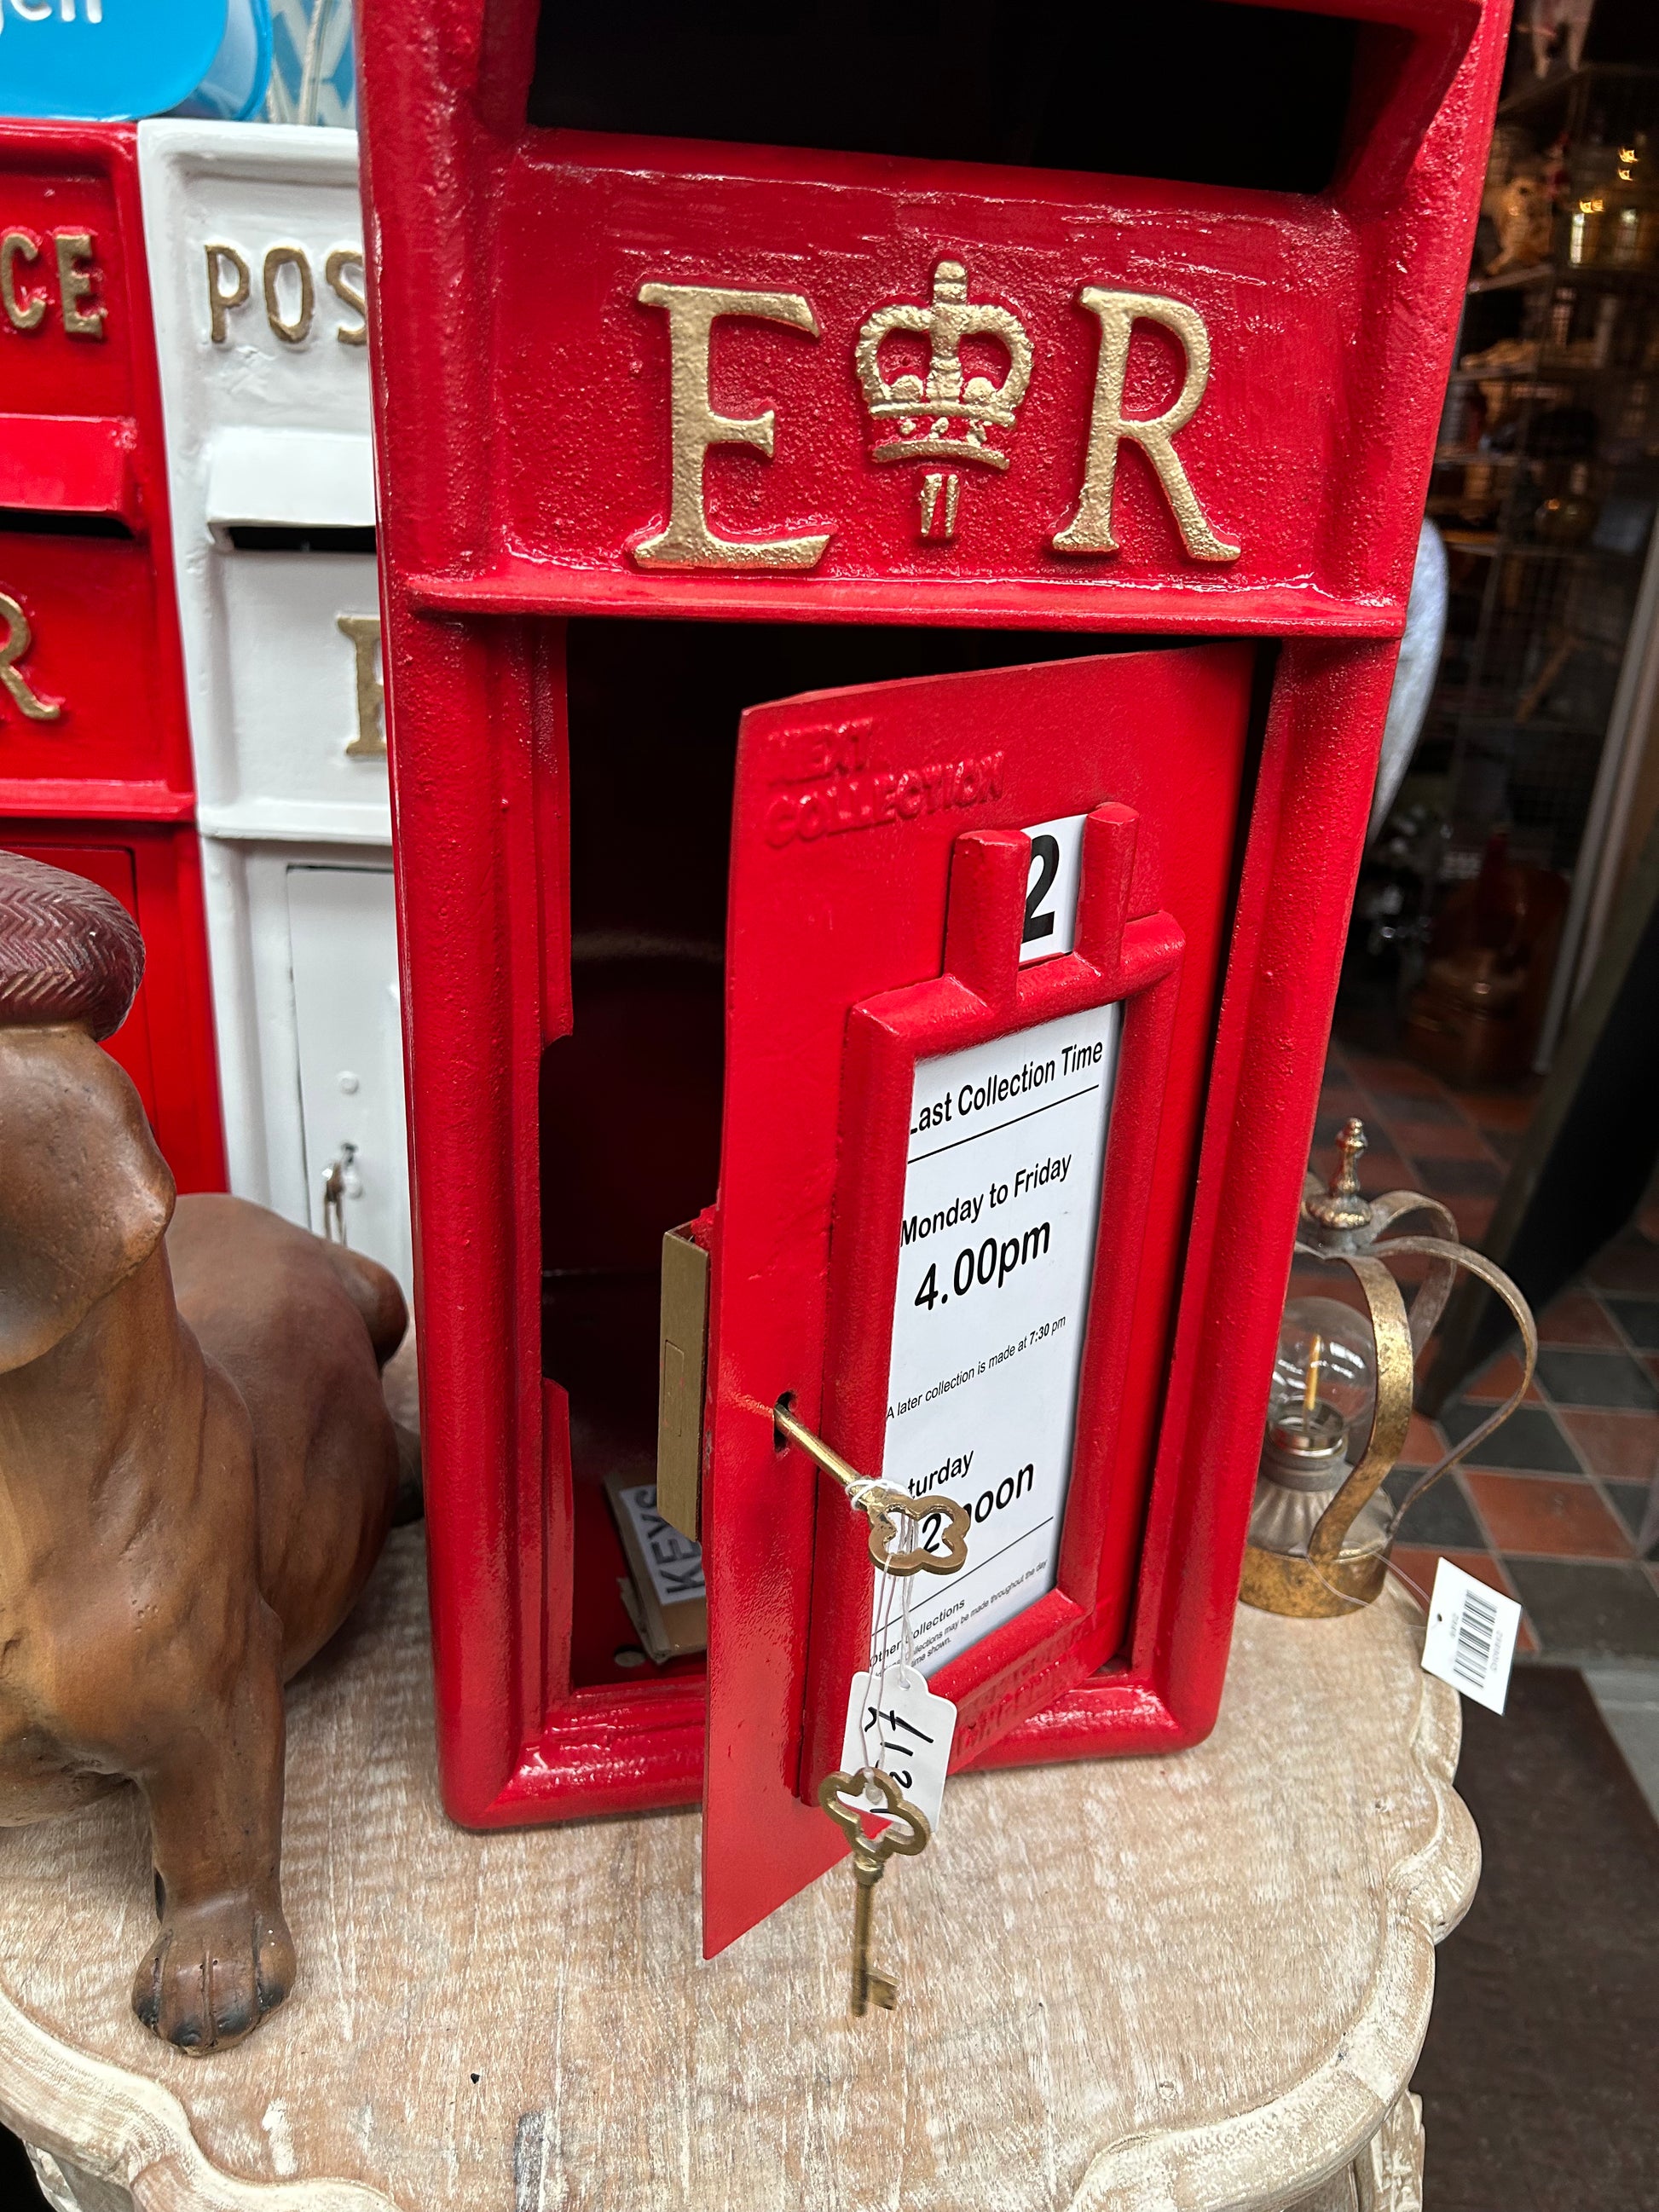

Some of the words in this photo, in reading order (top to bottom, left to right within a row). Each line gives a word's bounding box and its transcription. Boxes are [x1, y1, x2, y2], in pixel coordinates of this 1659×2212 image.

[636, 281, 833, 569] E
[1051, 286, 1242, 563] R
[1022, 835, 1060, 944] 2
[957, 1060, 1055, 1116] Collection
[1061, 1042, 1103, 1076] Time
[900, 1193, 984, 1248] Monday
[990, 1183, 1009, 1209] to
[1014, 1154, 1072, 1198] Friday
[914, 1222, 1050, 1311] 4.00pm
[887, 1406, 895, 1419] A
[897, 1395, 923, 1417] later
[925, 1368, 975, 1401] collection
[977, 1360, 986, 1375] is
[988, 1344, 1015, 1369] made
[1017, 1336, 1027, 1352] at
[1029, 1323, 1049, 1345] 7:30
[1051, 1316, 1066, 1336] pm
[944, 1620, 959, 1635] may
[961, 1614, 969, 1624] be
[970, 1600, 989, 1617] made
[990, 1574, 1025, 1603] throughout
[1025, 1568, 1036, 1580] the
[1036, 1559, 1048, 1572] day
